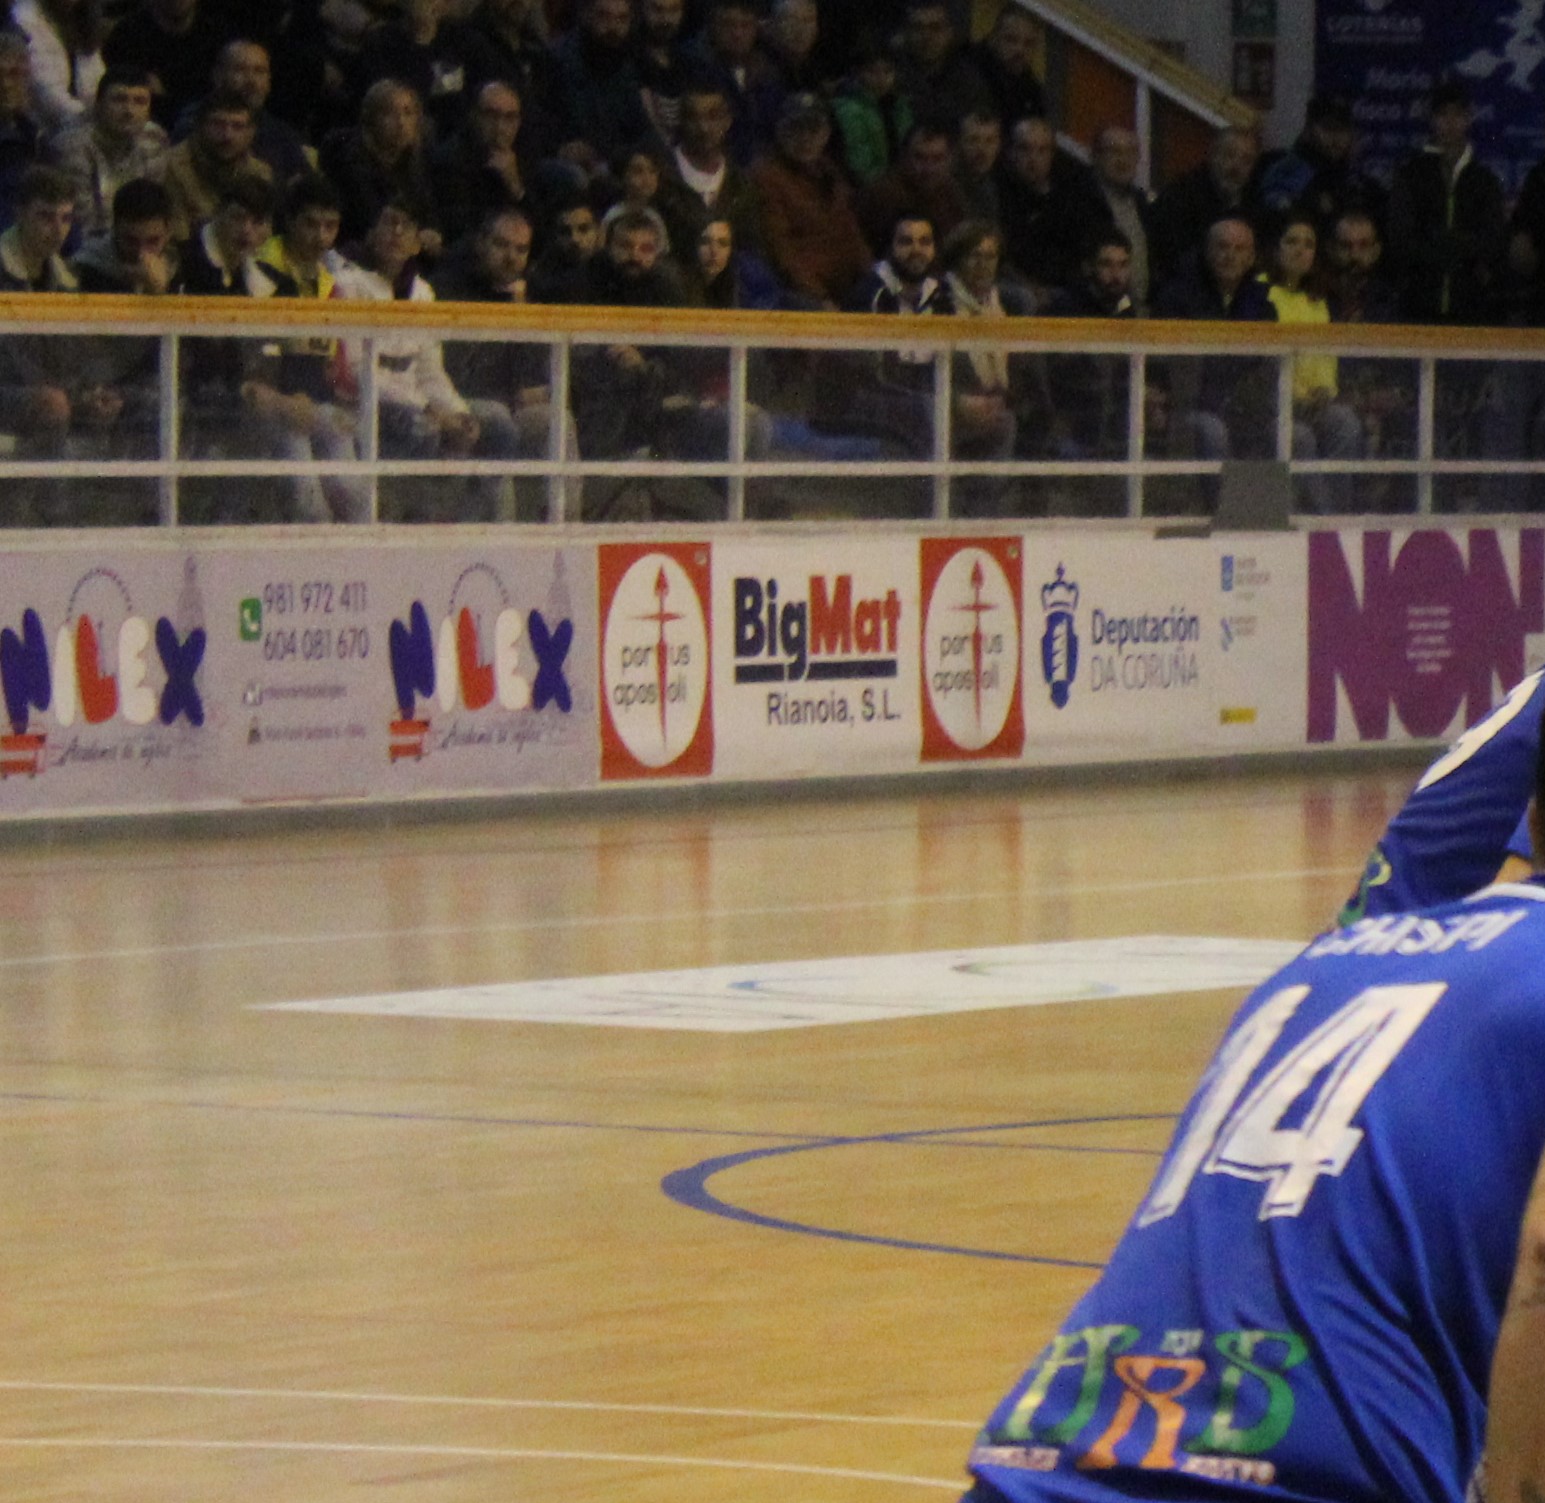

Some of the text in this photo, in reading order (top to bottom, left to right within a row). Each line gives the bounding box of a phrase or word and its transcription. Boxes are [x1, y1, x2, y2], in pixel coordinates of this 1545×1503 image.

[264, 582, 294, 614] 981
[301, 582, 334, 614] 972
[264, 629, 298, 662] 604
[337, 627, 370, 660] 670
[734, 575, 902, 681] BigMat
[1091, 605, 1200, 654] Deputación
[1091, 647, 1199, 692] DA CORUÑA
[767, 688, 902, 728] Rianoia, S.L.
[1138, 982, 1448, 1227] 14
